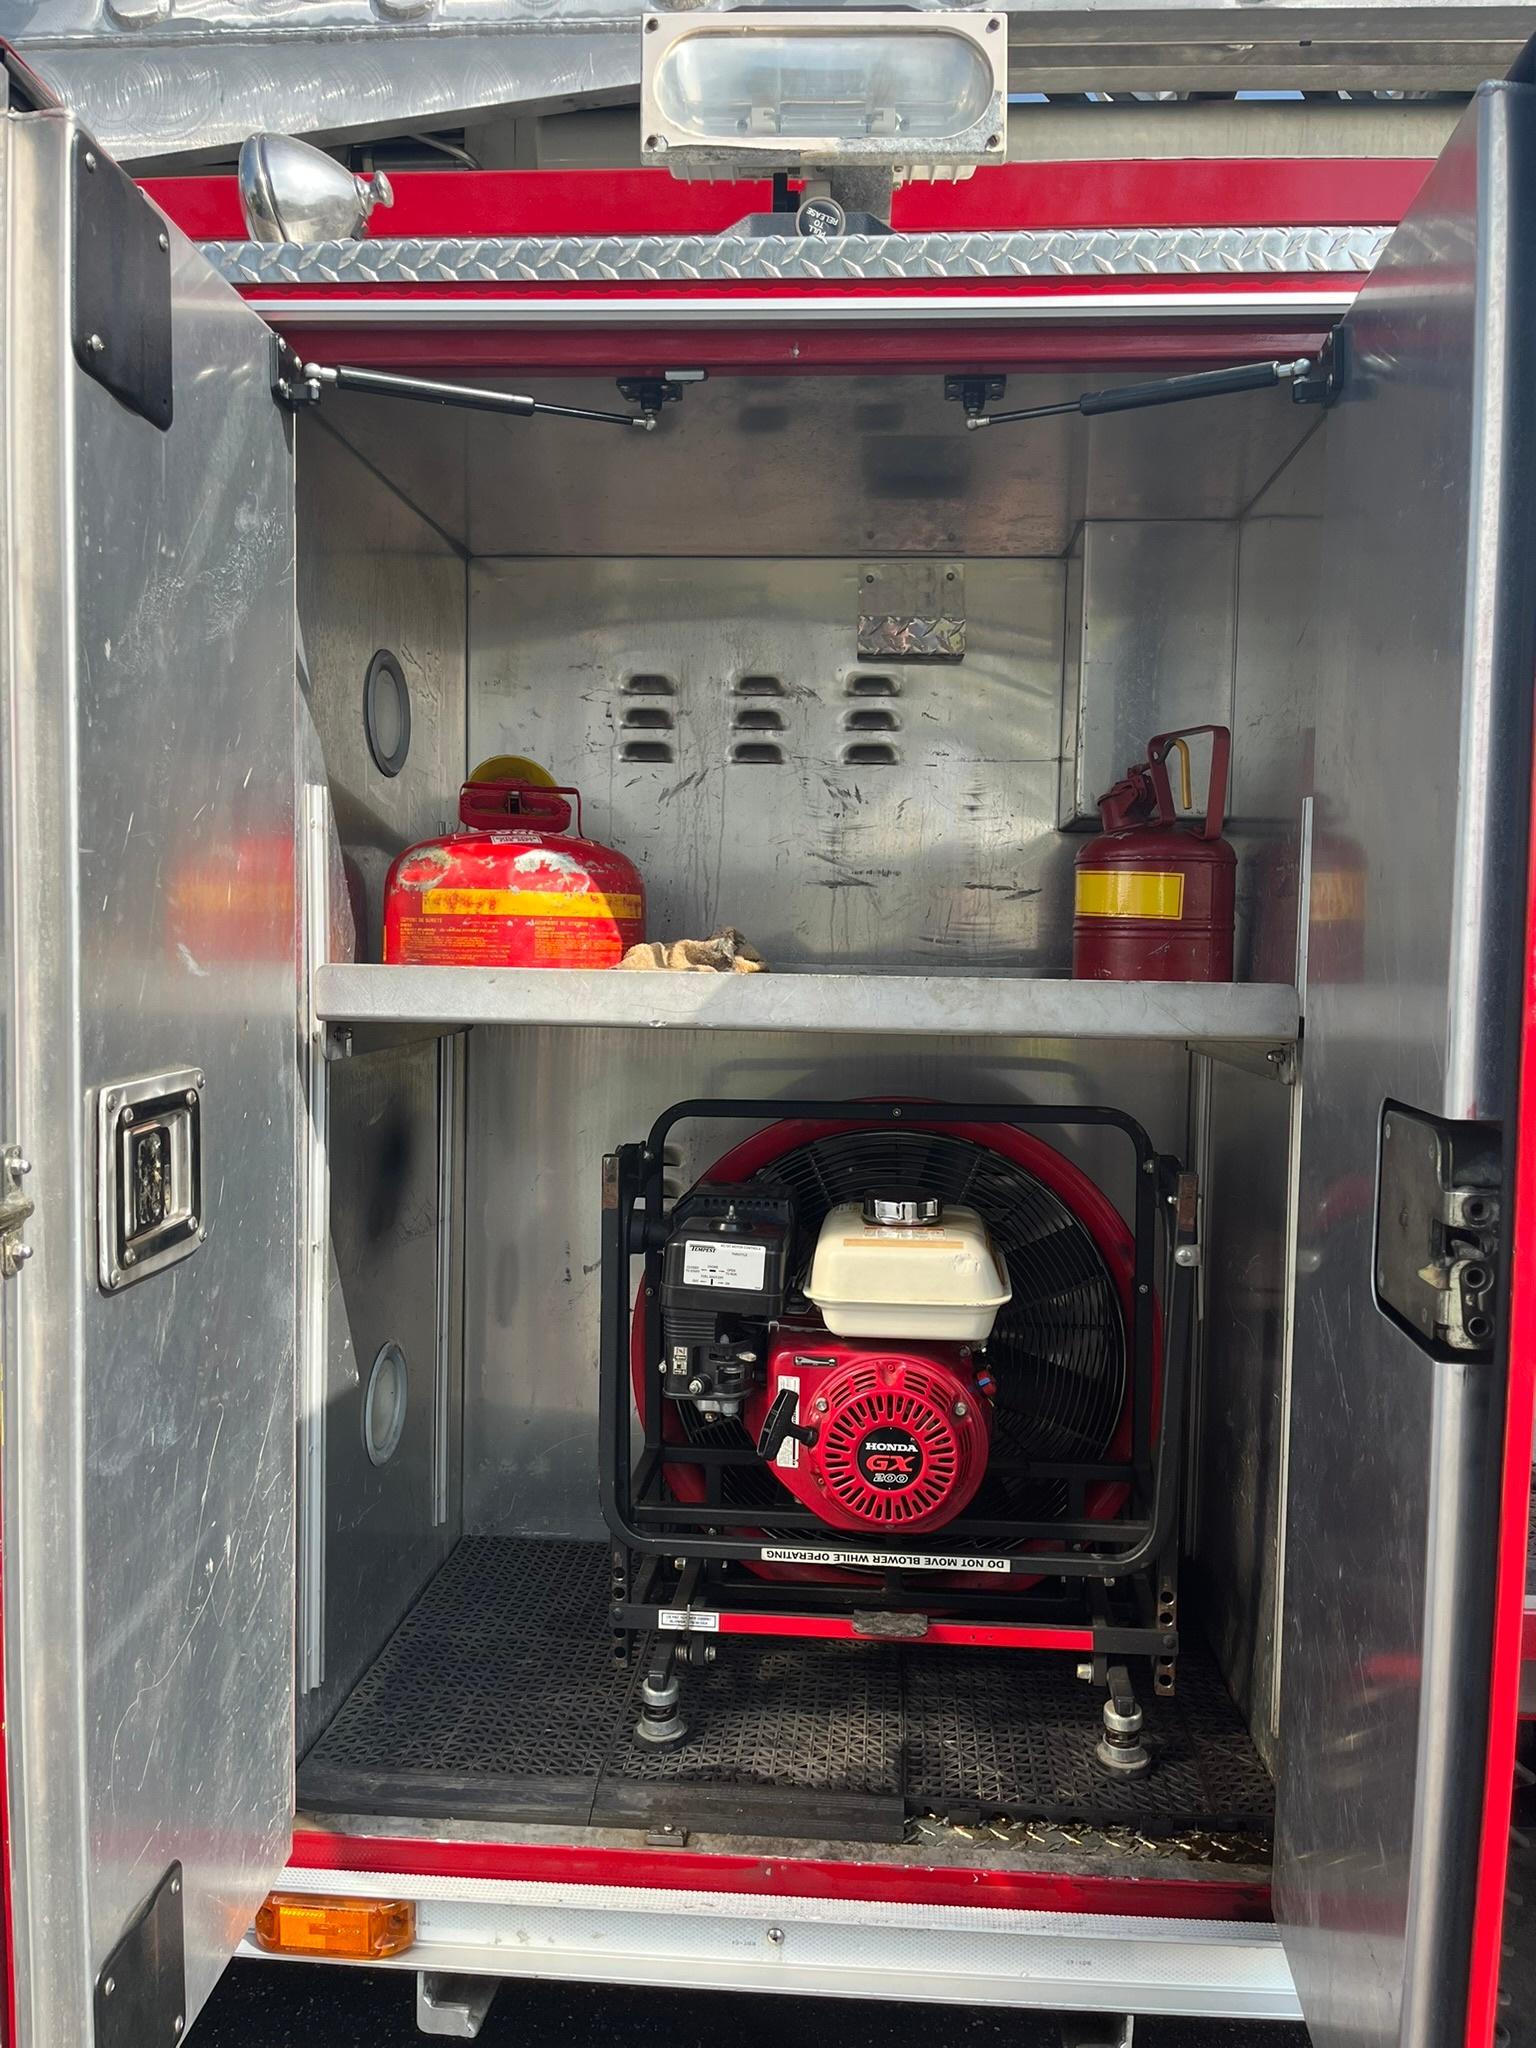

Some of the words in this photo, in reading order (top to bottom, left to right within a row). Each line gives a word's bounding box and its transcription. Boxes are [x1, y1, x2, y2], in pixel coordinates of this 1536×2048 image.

[806, 207, 839, 225] RELEASE
[813, 219, 824, 229] TO
[808, 224, 826, 238] PULL
[865, 1442, 919, 1452] HONDA
[866, 1454, 915, 1472] GX
[873, 1473, 908, 1483] 200
[766, 1550, 830, 1561] OPERATING
[833, 1552, 869, 1563] WHILE
[872, 1554, 920, 1566] BLOWER
[923, 1556, 958, 1567] MOVE
[961, 1558, 984, 1568] NOT
[987, 1559, 1004, 1569] DO
